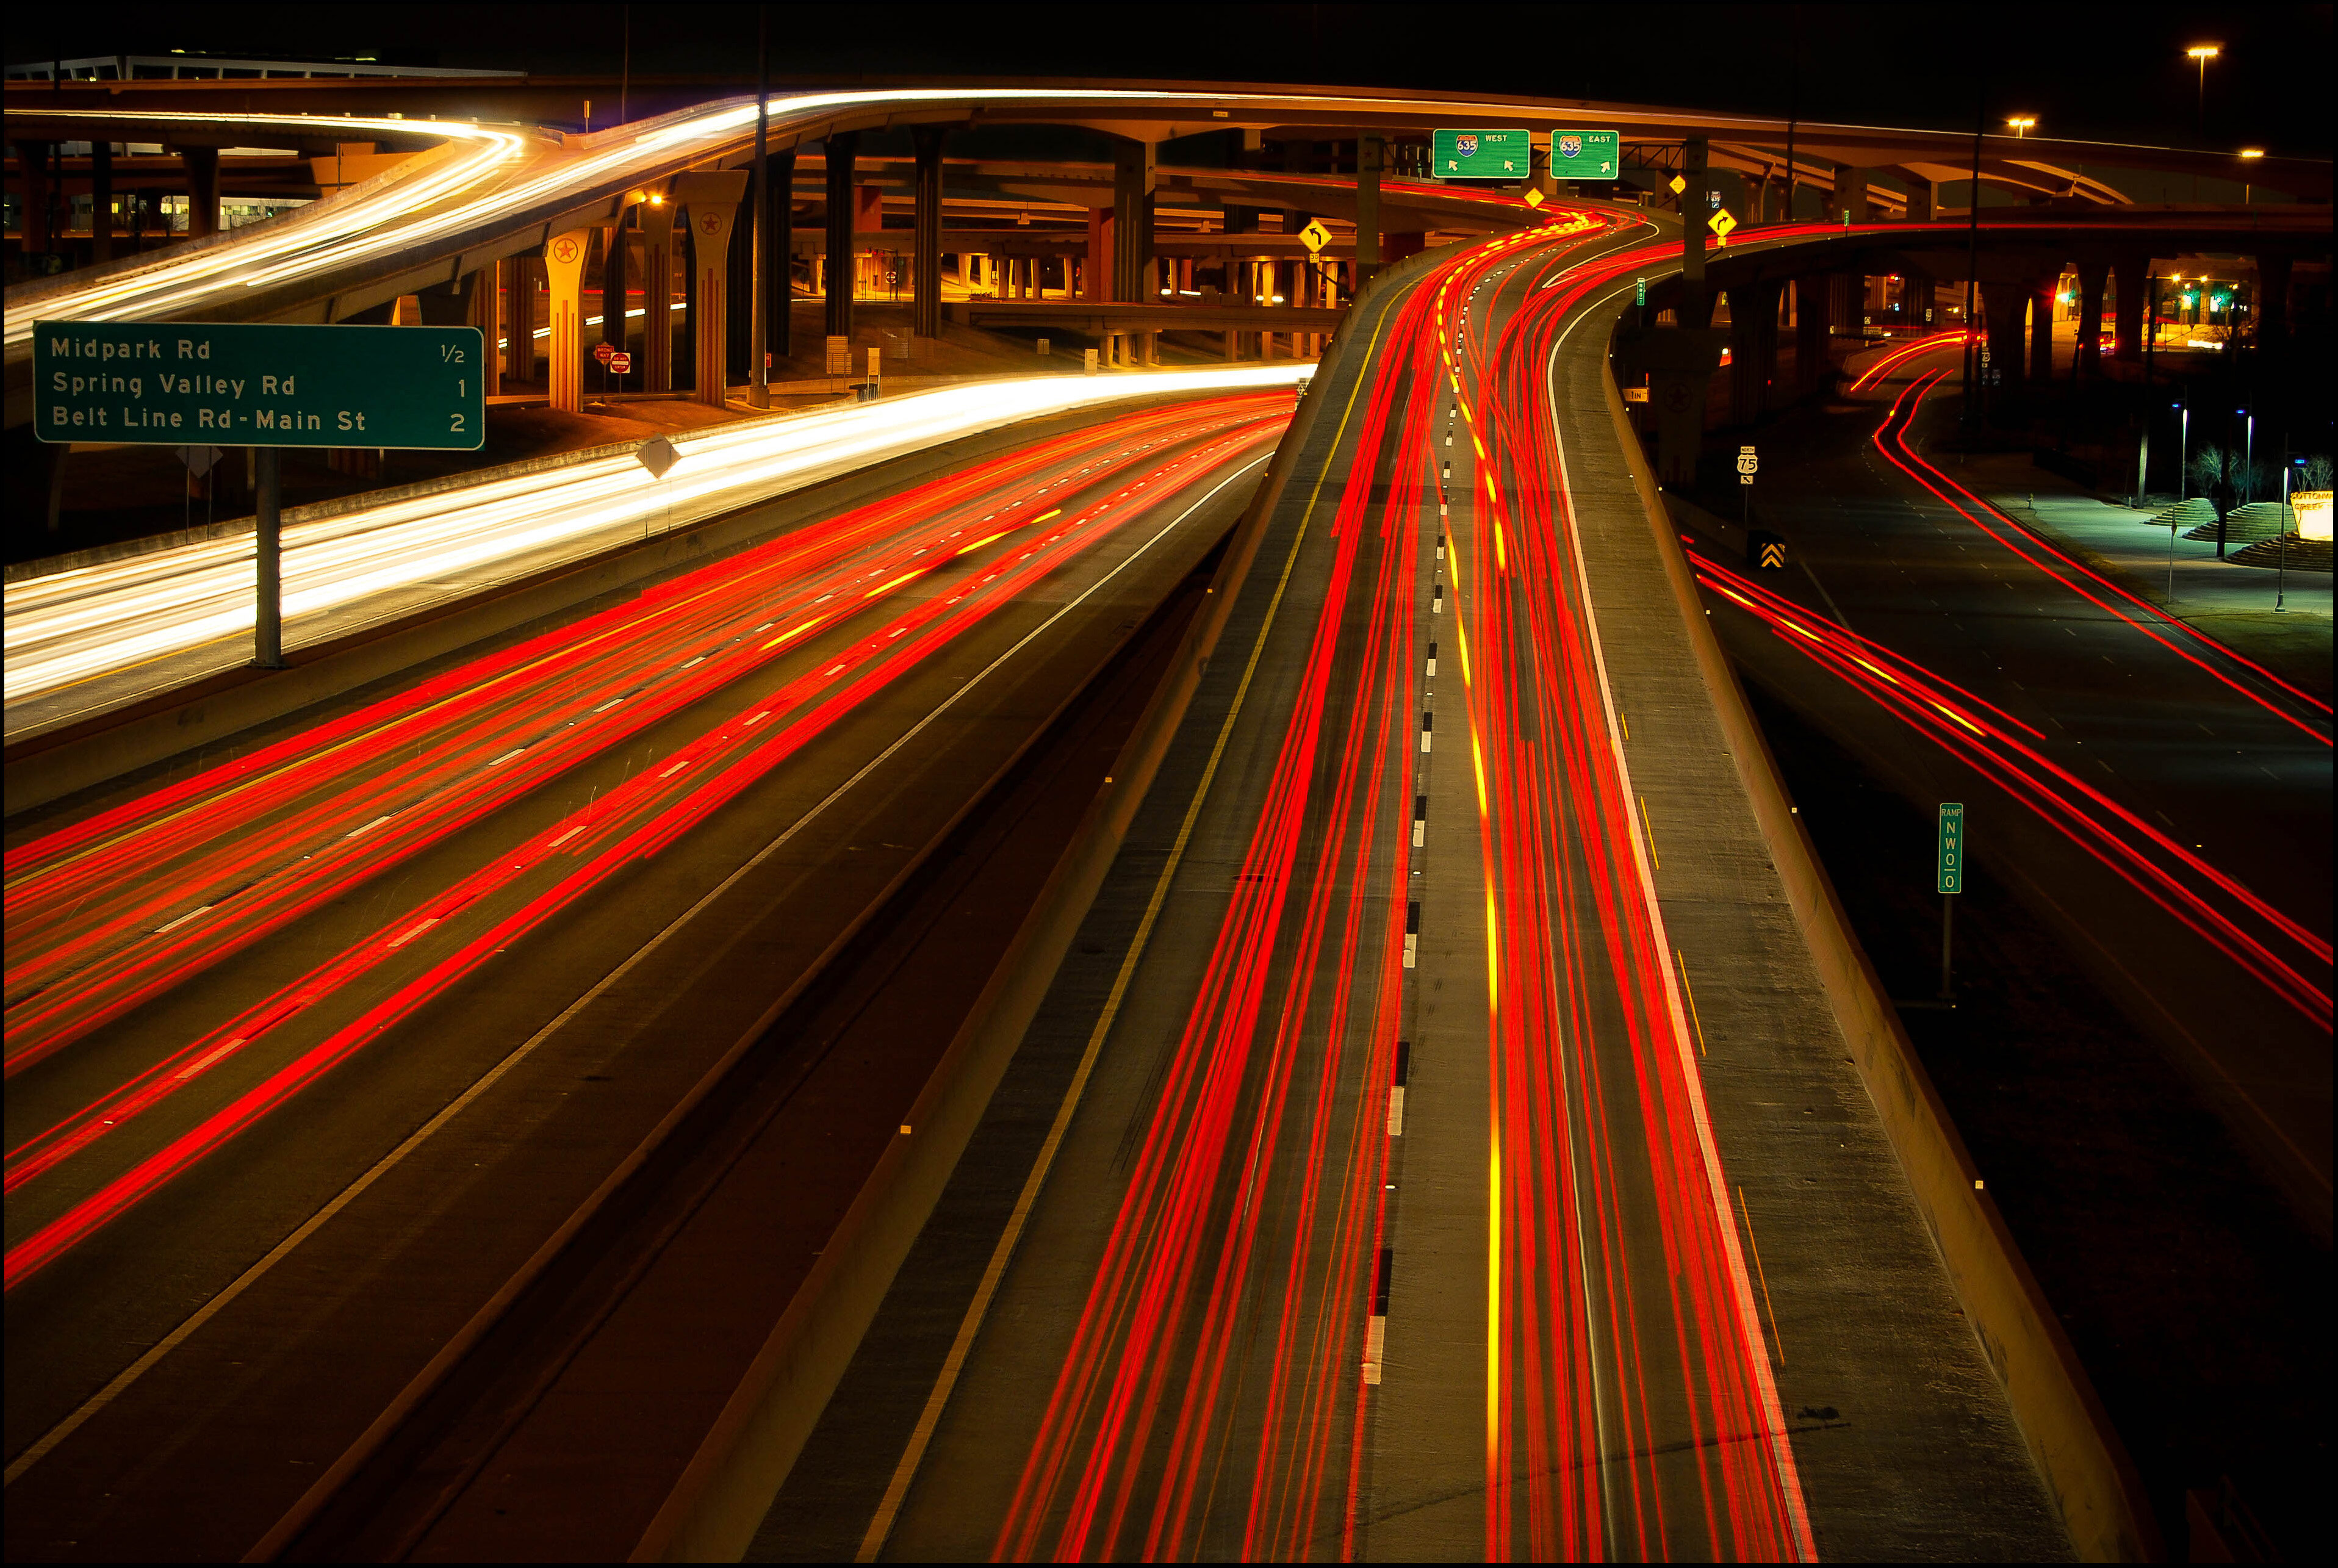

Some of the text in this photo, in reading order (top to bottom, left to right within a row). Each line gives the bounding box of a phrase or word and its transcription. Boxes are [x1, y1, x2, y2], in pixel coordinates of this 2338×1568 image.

[1457, 140, 1477, 151] 635
[1561, 141, 1581, 151] 635
[51, 337, 161, 361] Midpark
[178, 340, 210, 359] Rd
[53, 372, 465, 400] Spring Valley Rd 1
[53, 406, 107, 426] Belt
[124, 407, 182, 427] Line
[337, 411, 365, 431] St
[450, 414, 465, 432] 2
[1739, 459, 1756, 470] 75
